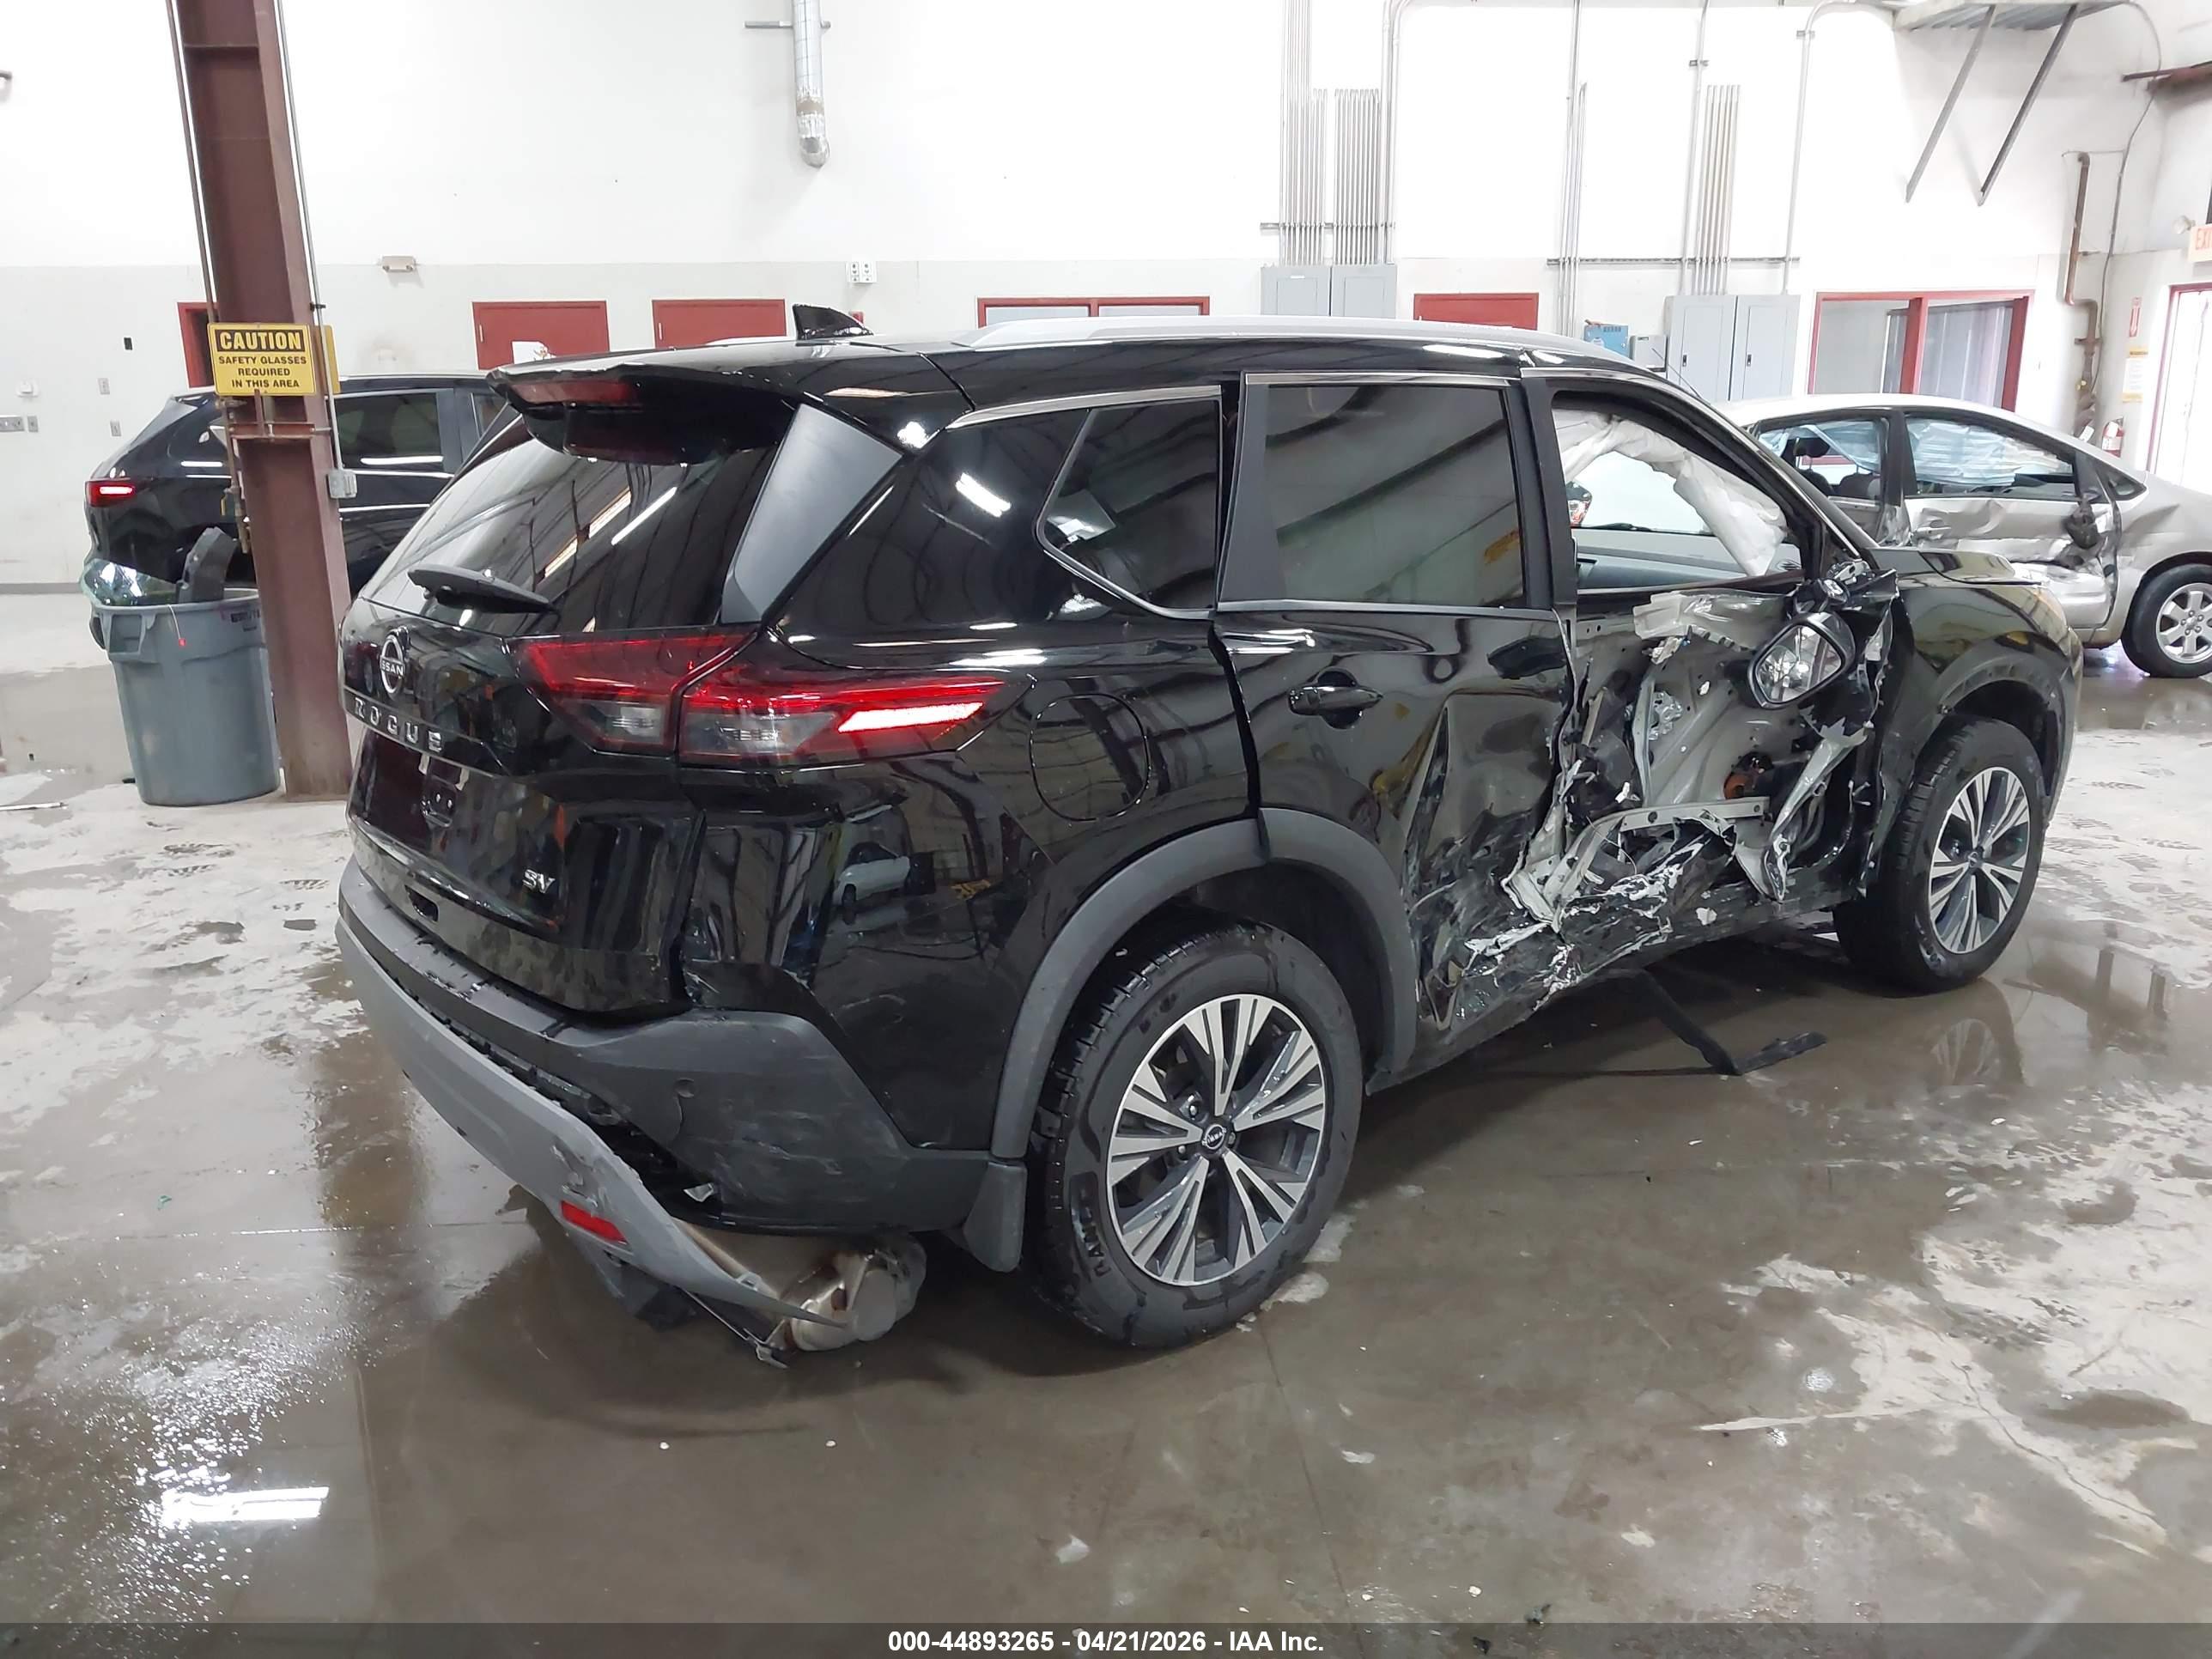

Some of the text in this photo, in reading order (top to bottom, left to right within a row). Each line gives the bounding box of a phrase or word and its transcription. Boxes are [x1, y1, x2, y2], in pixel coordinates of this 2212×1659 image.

[2196, 228, 2212, 250] EXI
[220, 332, 301, 349] CAUTION
[219, 356, 307, 365] SAFETY GLASSES
[381, 659, 404, 676] SSAN
[355, 697, 441, 753] ROGUE
[522, 869, 556, 894] SV
